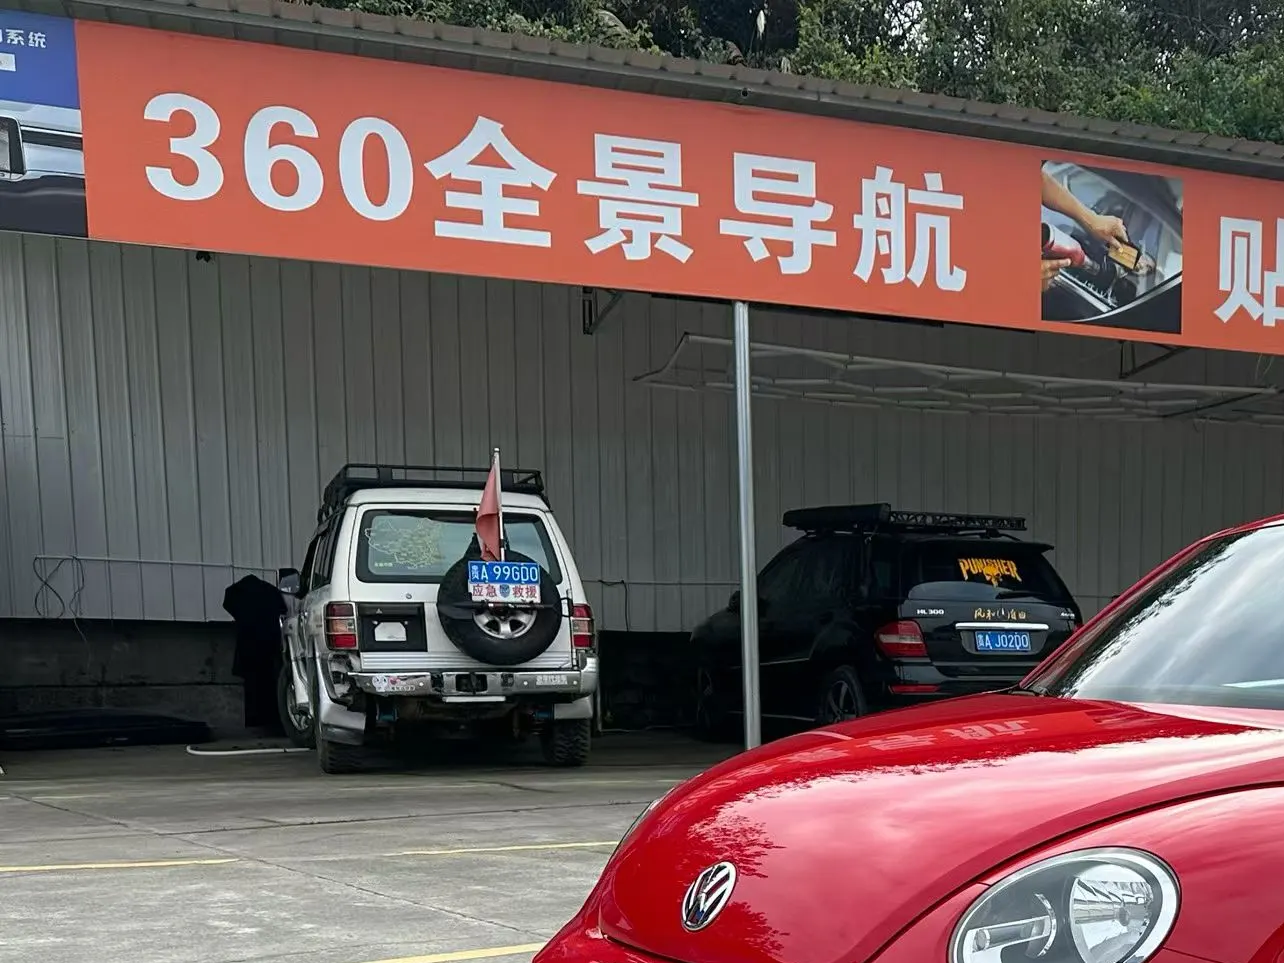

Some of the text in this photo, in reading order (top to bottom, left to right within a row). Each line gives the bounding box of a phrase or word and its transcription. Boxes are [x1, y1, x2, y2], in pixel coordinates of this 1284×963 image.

[0, 29, 47, 49] 系统
[142, 92, 968, 293] 360全景导航
[472, 584, 497, 598] 应急
